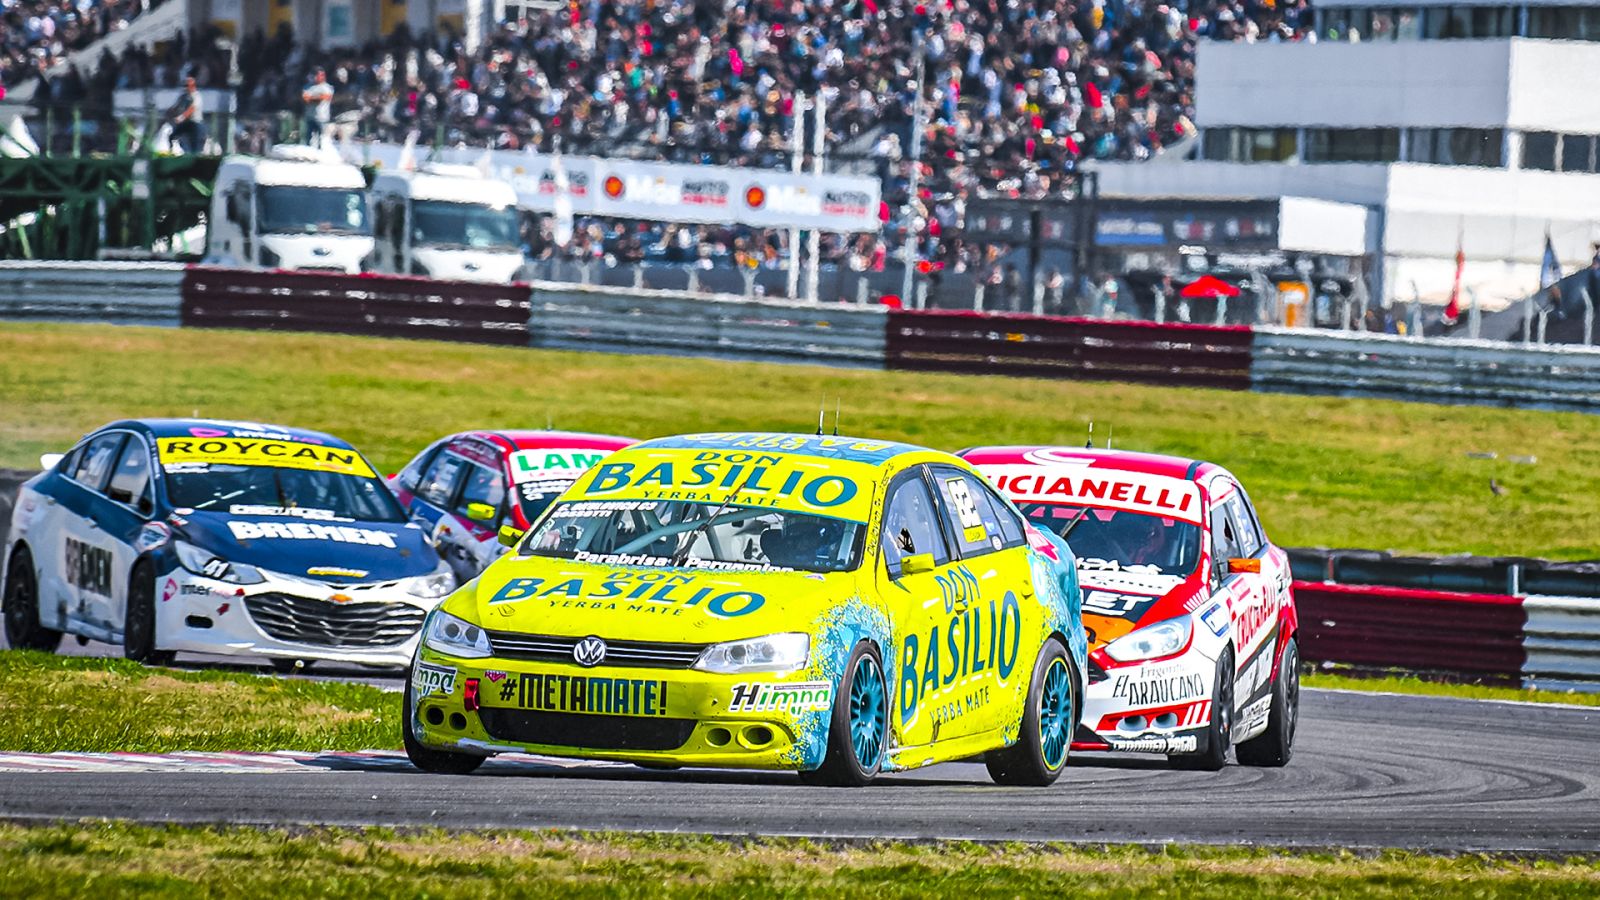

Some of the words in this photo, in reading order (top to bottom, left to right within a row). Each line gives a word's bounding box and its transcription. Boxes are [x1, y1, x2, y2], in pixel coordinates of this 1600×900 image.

[166, 441, 354, 465] ROYCAN
[694, 451, 784, 466] DON
[585, 462, 858, 507] BASILIO
[643, 490, 711, 501] YERBA
[723, 494, 780, 506] MATE
[227, 520, 397, 549] BREMEN
[203, 559, 229, 578] 41
[606, 571, 696, 585] DON
[488, 578, 766, 618] BASILIO
[934, 563, 981, 614] DON
[1080, 588, 1153, 612] ET
[550, 600, 616, 610] YERBA
[627, 604, 684, 617] MATE
[901, 590, 1021, 727] BASILIO
[499, 672, 667, 716] #METAMATE!
[731, 684, 830, 716] Himpa
[1112, 674, 1130, 699] EL
[1128, 673, 1205, 706] ARAUCANO
[929, 699, 963, 727] YERBA
[965, 685, 990, 714] MATE
